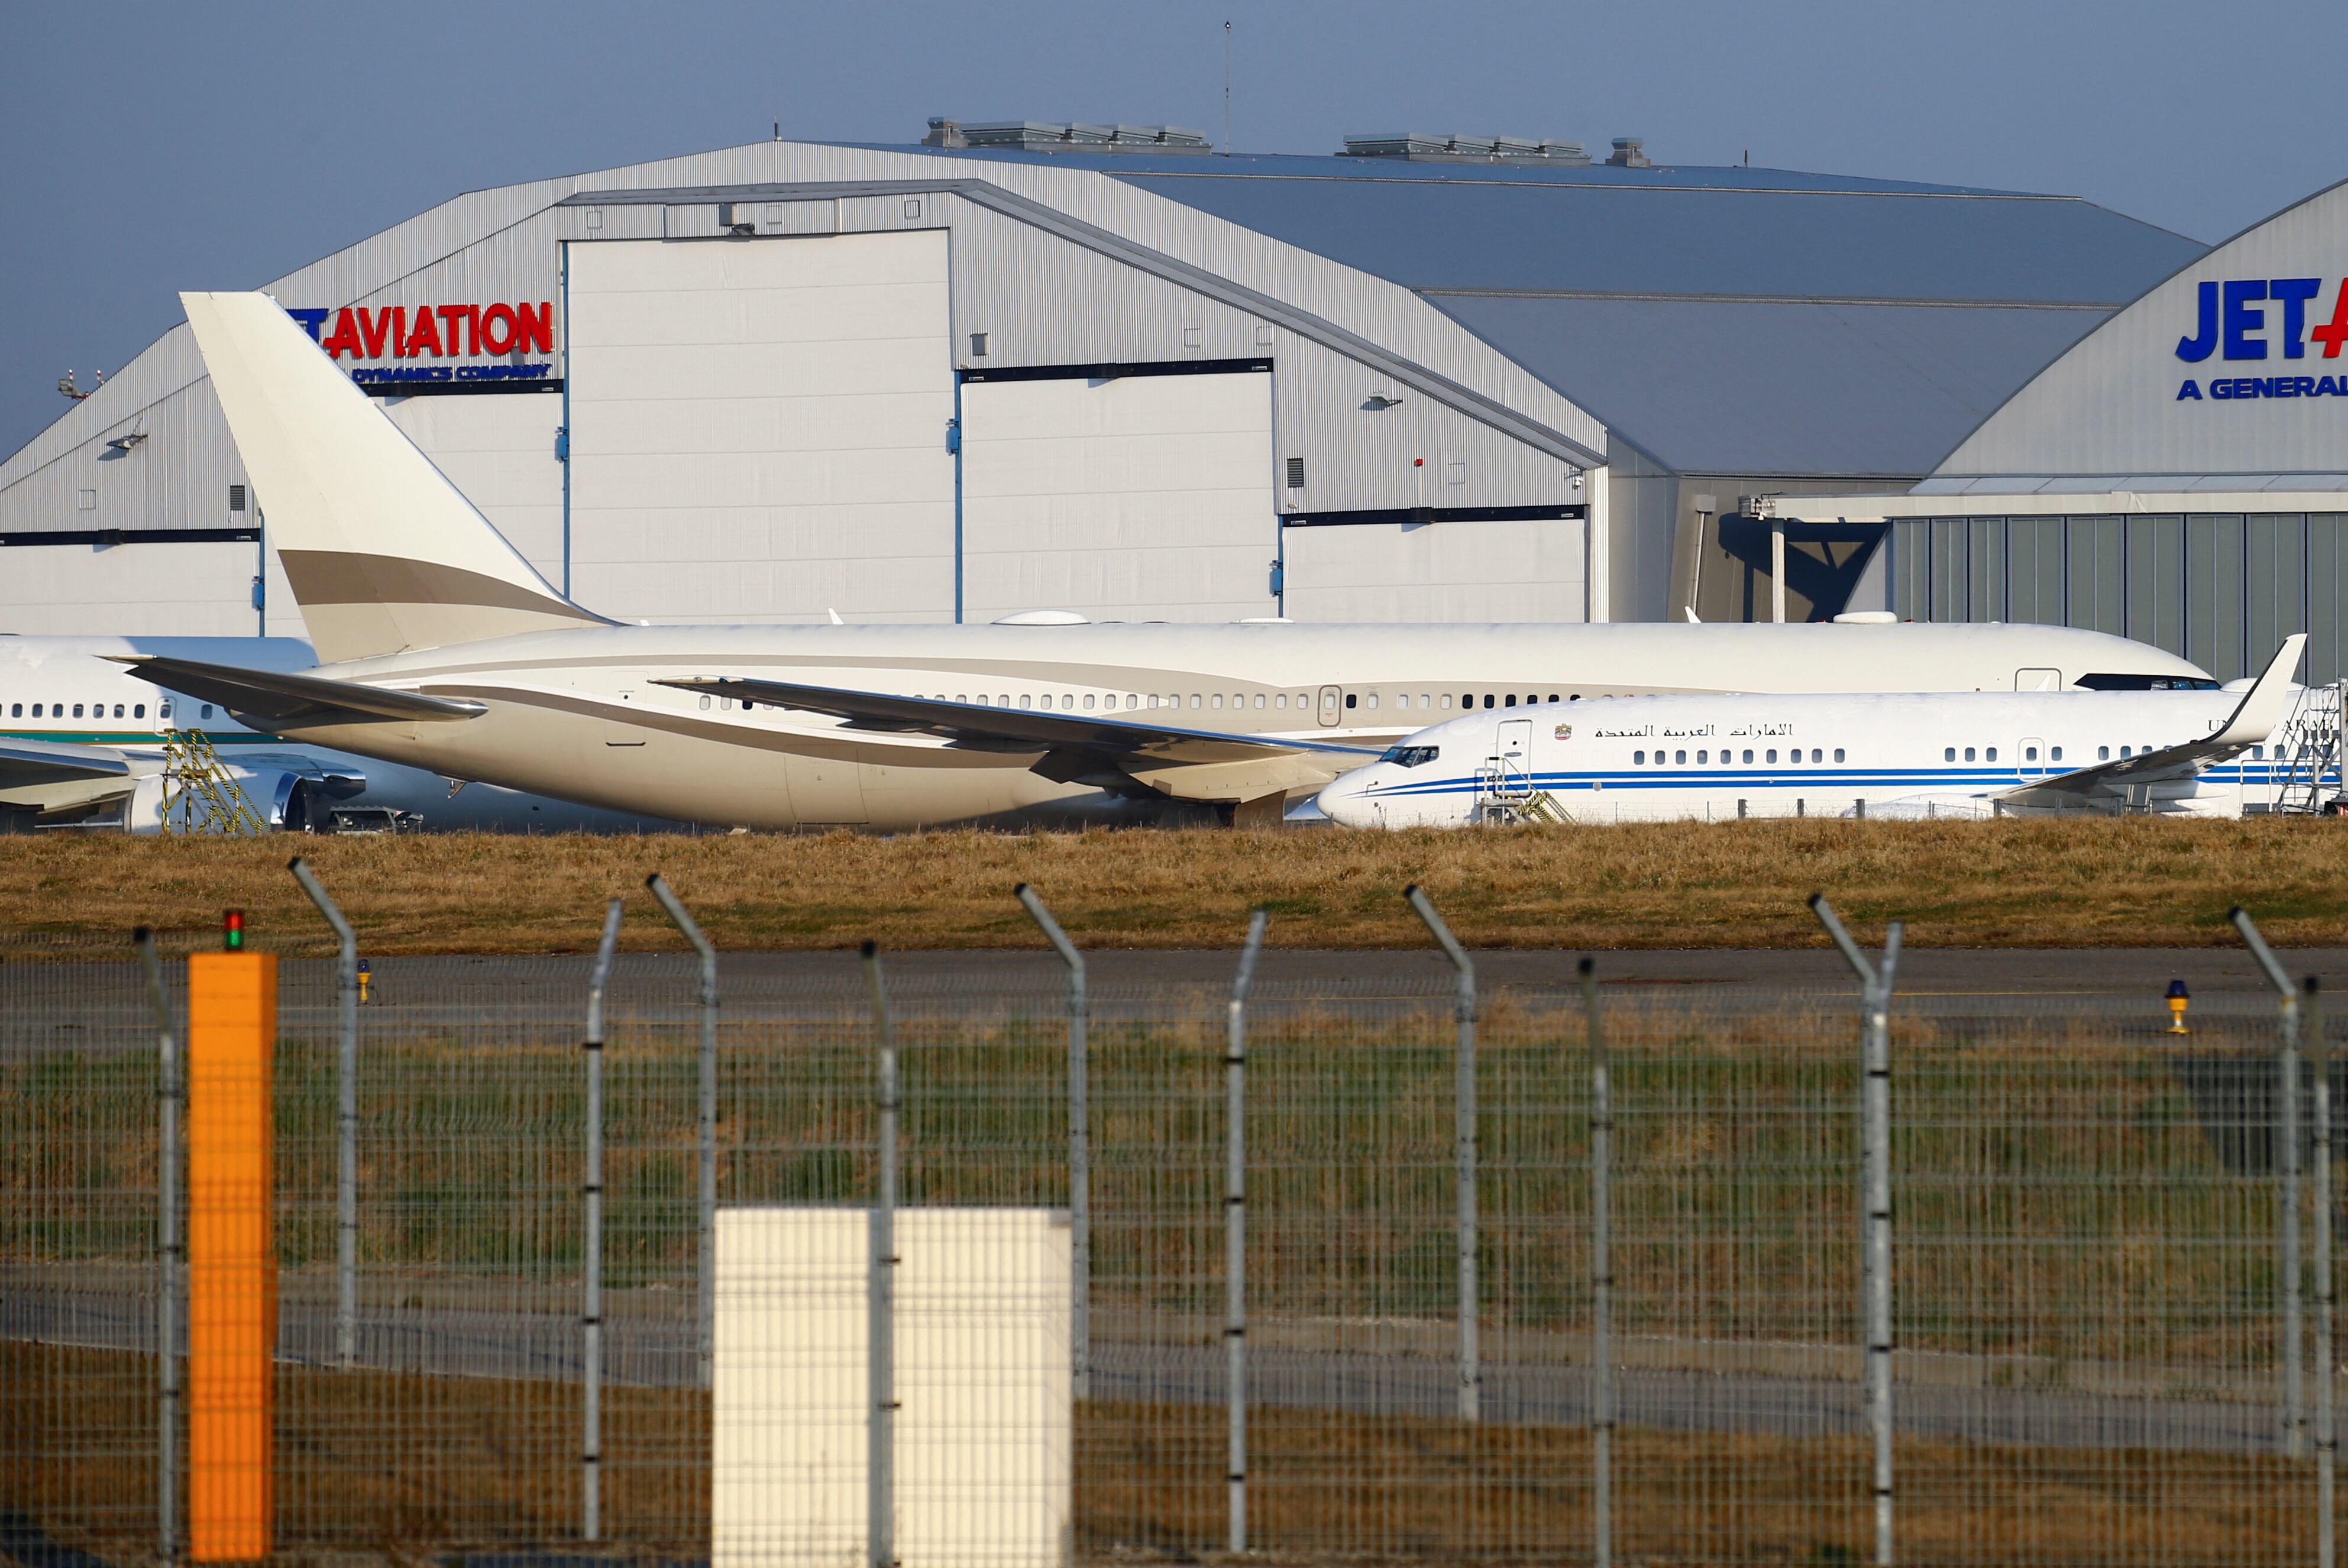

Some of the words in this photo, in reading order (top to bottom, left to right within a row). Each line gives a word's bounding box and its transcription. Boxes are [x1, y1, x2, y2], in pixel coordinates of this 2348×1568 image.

[322, 302, 552, 359] AVIATION
[2175, 278, 2322, 363] JET
[352, 364, 453, 383] DYNAMICS
[456, 363, 554, 380] COMPANY
[2176, 380, 2204, 400] A
[1595, 724, 1655, 737] المتحدة
[1664, 724, 1716, 741] العربية
